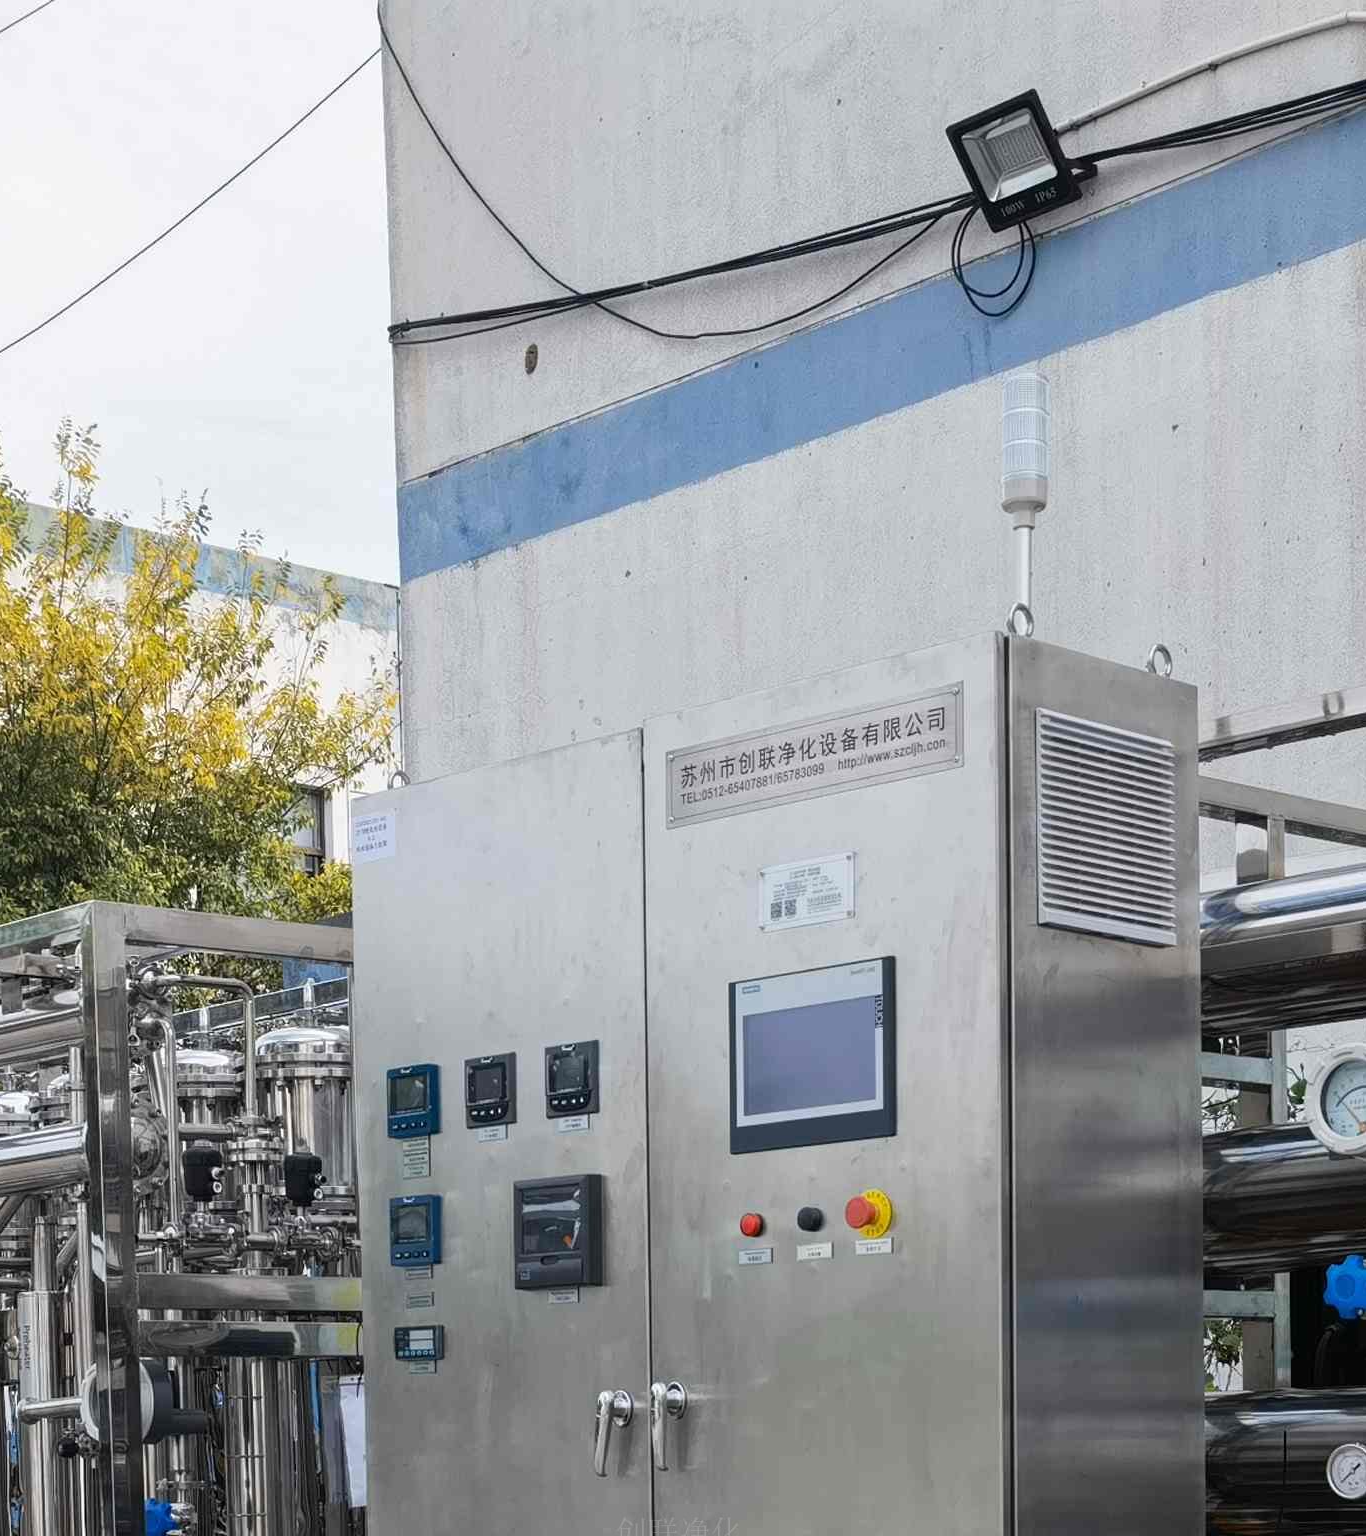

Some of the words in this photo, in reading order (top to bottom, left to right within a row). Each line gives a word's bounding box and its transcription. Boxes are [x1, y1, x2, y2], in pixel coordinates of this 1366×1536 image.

[681, 707, 945, 788] 苏州市创联净化设备有限公司
